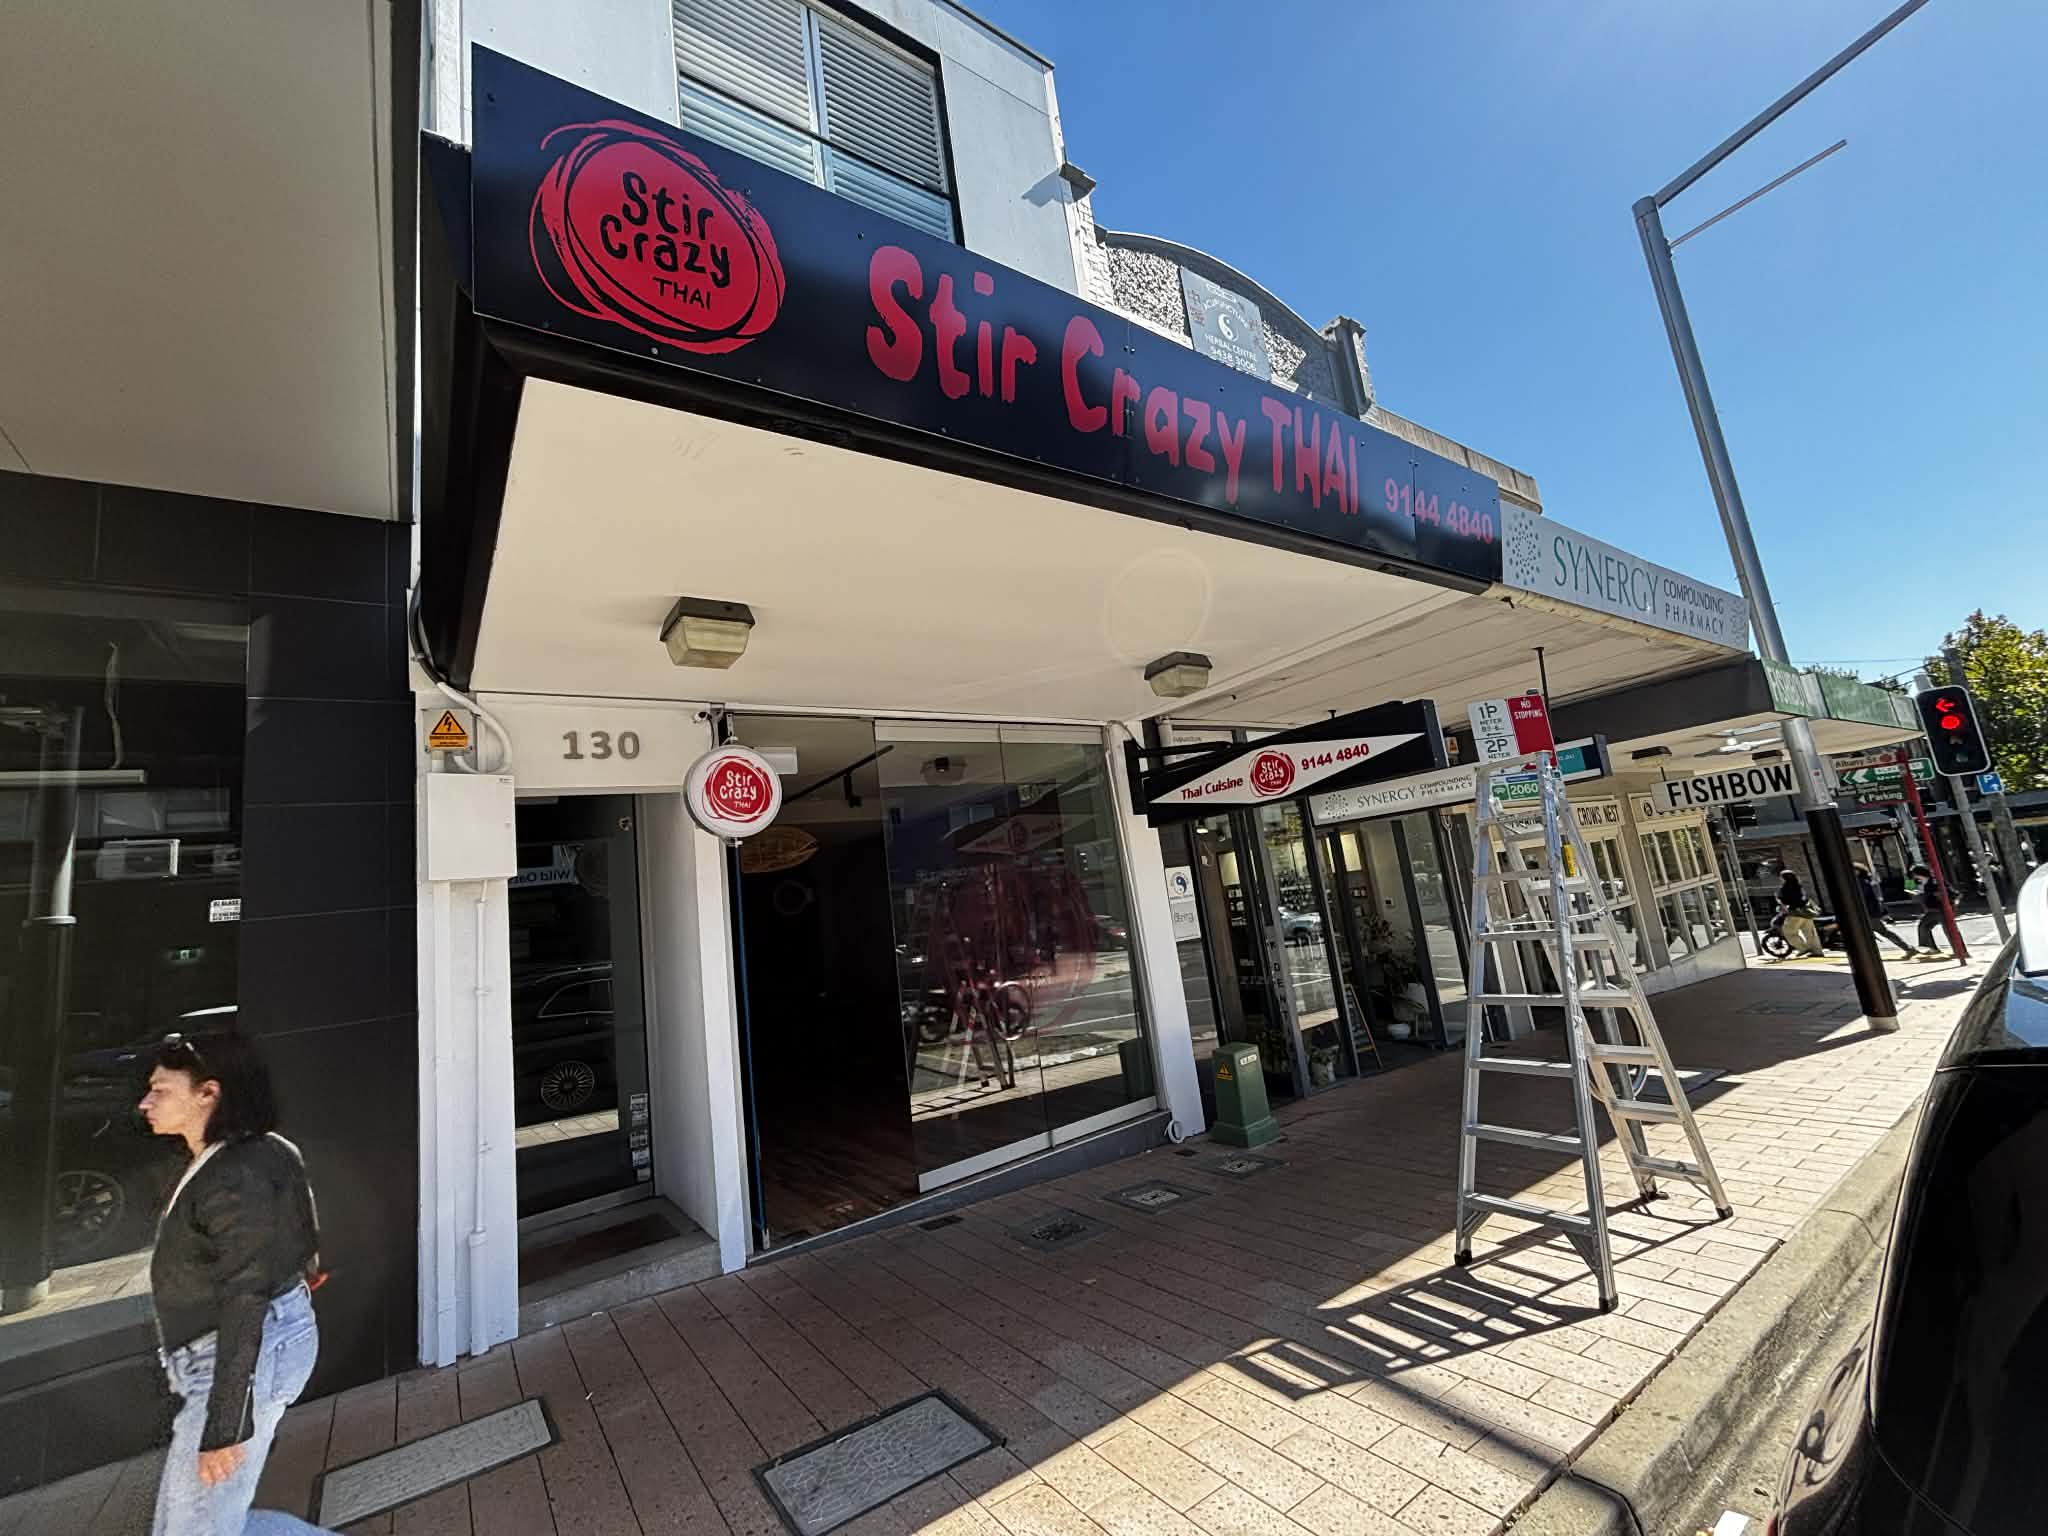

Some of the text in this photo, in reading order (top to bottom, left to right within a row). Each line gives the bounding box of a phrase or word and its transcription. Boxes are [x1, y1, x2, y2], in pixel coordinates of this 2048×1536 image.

[622, 172, 714, 240] Stir
[600, 215, 730, 288] Crazy
[652, 277, 712, 310] THAI
[866, 245, 1360, 515] Stir Crazy THAI
[1384, 478, 1494, 545] 9144 4840
[1553, 536, 1725, 614] SYNERGY COMPOUNDING
[1664, 603, 1725, 634] PHARMACY
[1478, 704, 1497, 719] 1P
[1514, 709, 1543, 720] STOPPING
[1520, 700, 1531, 709] NO
[562, 730, 640, 760] 130
[1485, 738, 1508, 753] 2P
[1261, 759, 1279, 774] Stir
[1301, 743, 1369, 770] 9144 4840
[725, 770, 753, 788] Stir
[1259, 766, 1285, 783] Crazy
[719, 785, 757, 801] Crazy
[1181, 777, 1244, 800] Thai Cuisine
[1357, 785, 1416, 808] SYNERGY
[1421, 782, 1473, 797] PHARMACY
[1510, 783, 1539, 795] 2060
[734, 801, 751, 809] THAI
[1577, 804, 1619, 826] CROWS NEST
